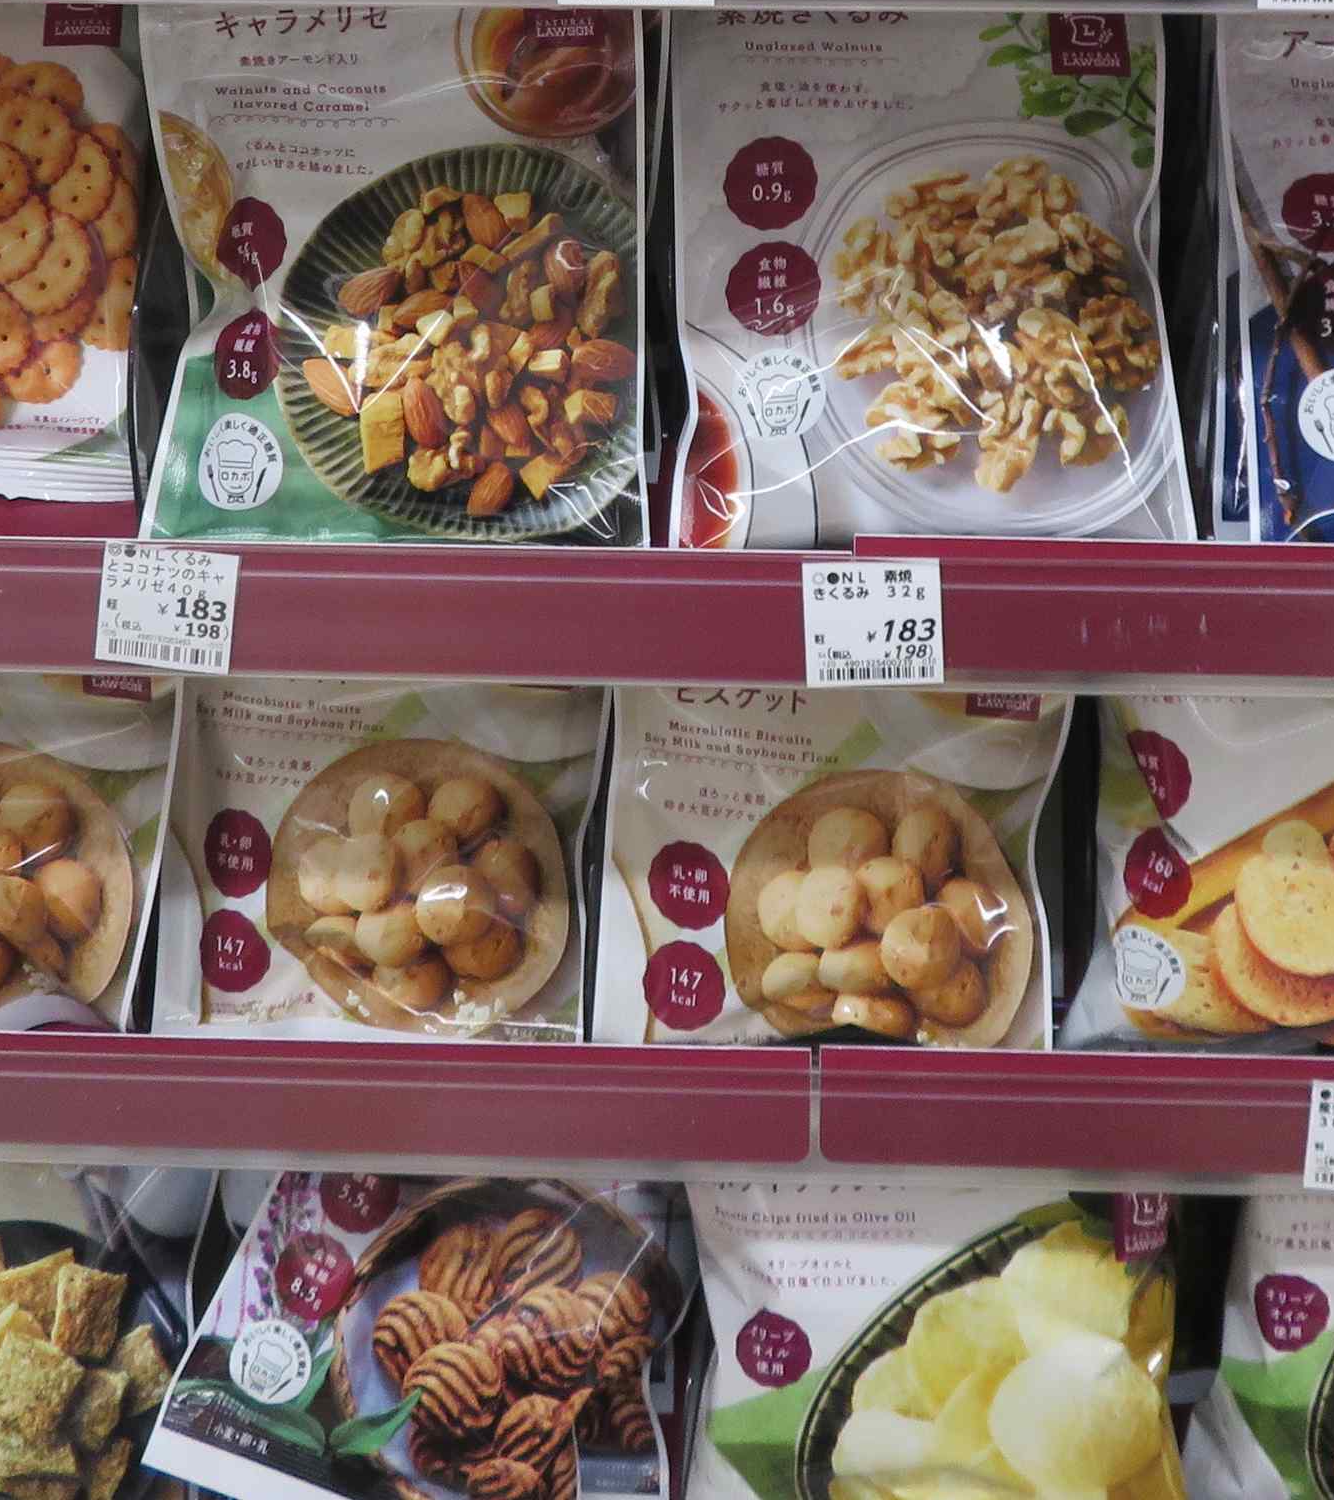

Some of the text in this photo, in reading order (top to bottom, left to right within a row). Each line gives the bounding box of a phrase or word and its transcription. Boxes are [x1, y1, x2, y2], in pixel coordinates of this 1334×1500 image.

[54, 23, 111, 36] LAWSON
[536, 25, 595, 37] LAWSON
[215, 84, 386, 96] Walnuts and Coconuts
[233, 100, 369, 112] flavored Caramel
[751, 181, 793, 203] 0.9g
[759, 256, 788, 271] 食物
[753, 297, 795, 318] 1.6g
[227, 357, 259, 384] 3.8g
[884, 570, 913, 583] 素焼
[813, 586, 925, 600] きくるみ 32g
[220, 831, 252, 849] 乳・卵
[217, 852, 255, 871] 不使用
[1146, 851, 1174, 879] 160
[671, 866, 708, 884] 乳・卵
[668, 884, 711, 904] 不使用
[215, 935, 244, 955] 147
[218, 957, 244, 972] kcal
[668, 967, 702, 989] 147
[671, 991, 697, 1008] kcal
[852, 1211, 888, 1224] Olive
[288, 1276, 321, 1312] 8.5g
[1269, 1307, 1307, 1323] オイル
[1273, 1325, 1302, 1341] 使用
[751, 1345, 789, 1359] オイル
[755, 1361, 785, 1376] 使用
